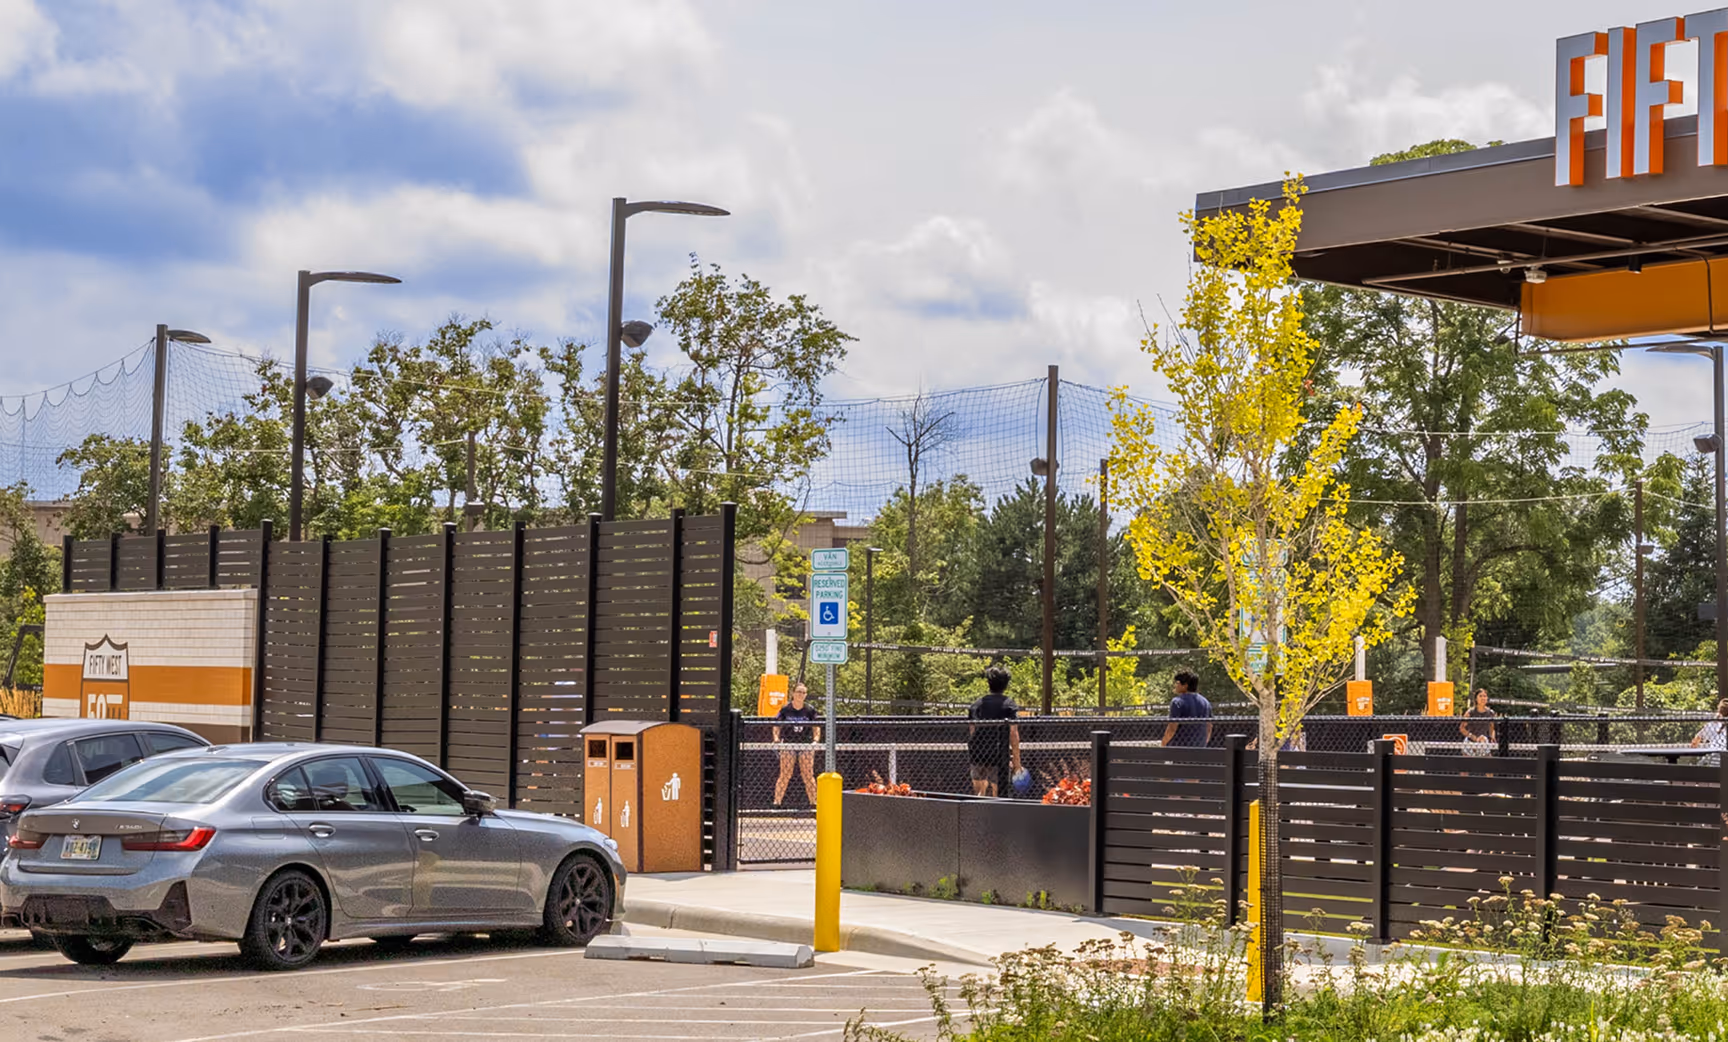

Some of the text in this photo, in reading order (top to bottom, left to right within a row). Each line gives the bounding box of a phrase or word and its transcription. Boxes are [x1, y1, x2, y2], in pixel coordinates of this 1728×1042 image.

[814, 580, 845, 588] RESERVED
[816, 590, 844, 599] PARKING
[89, 655, 122, 676] FIFTY WEST
